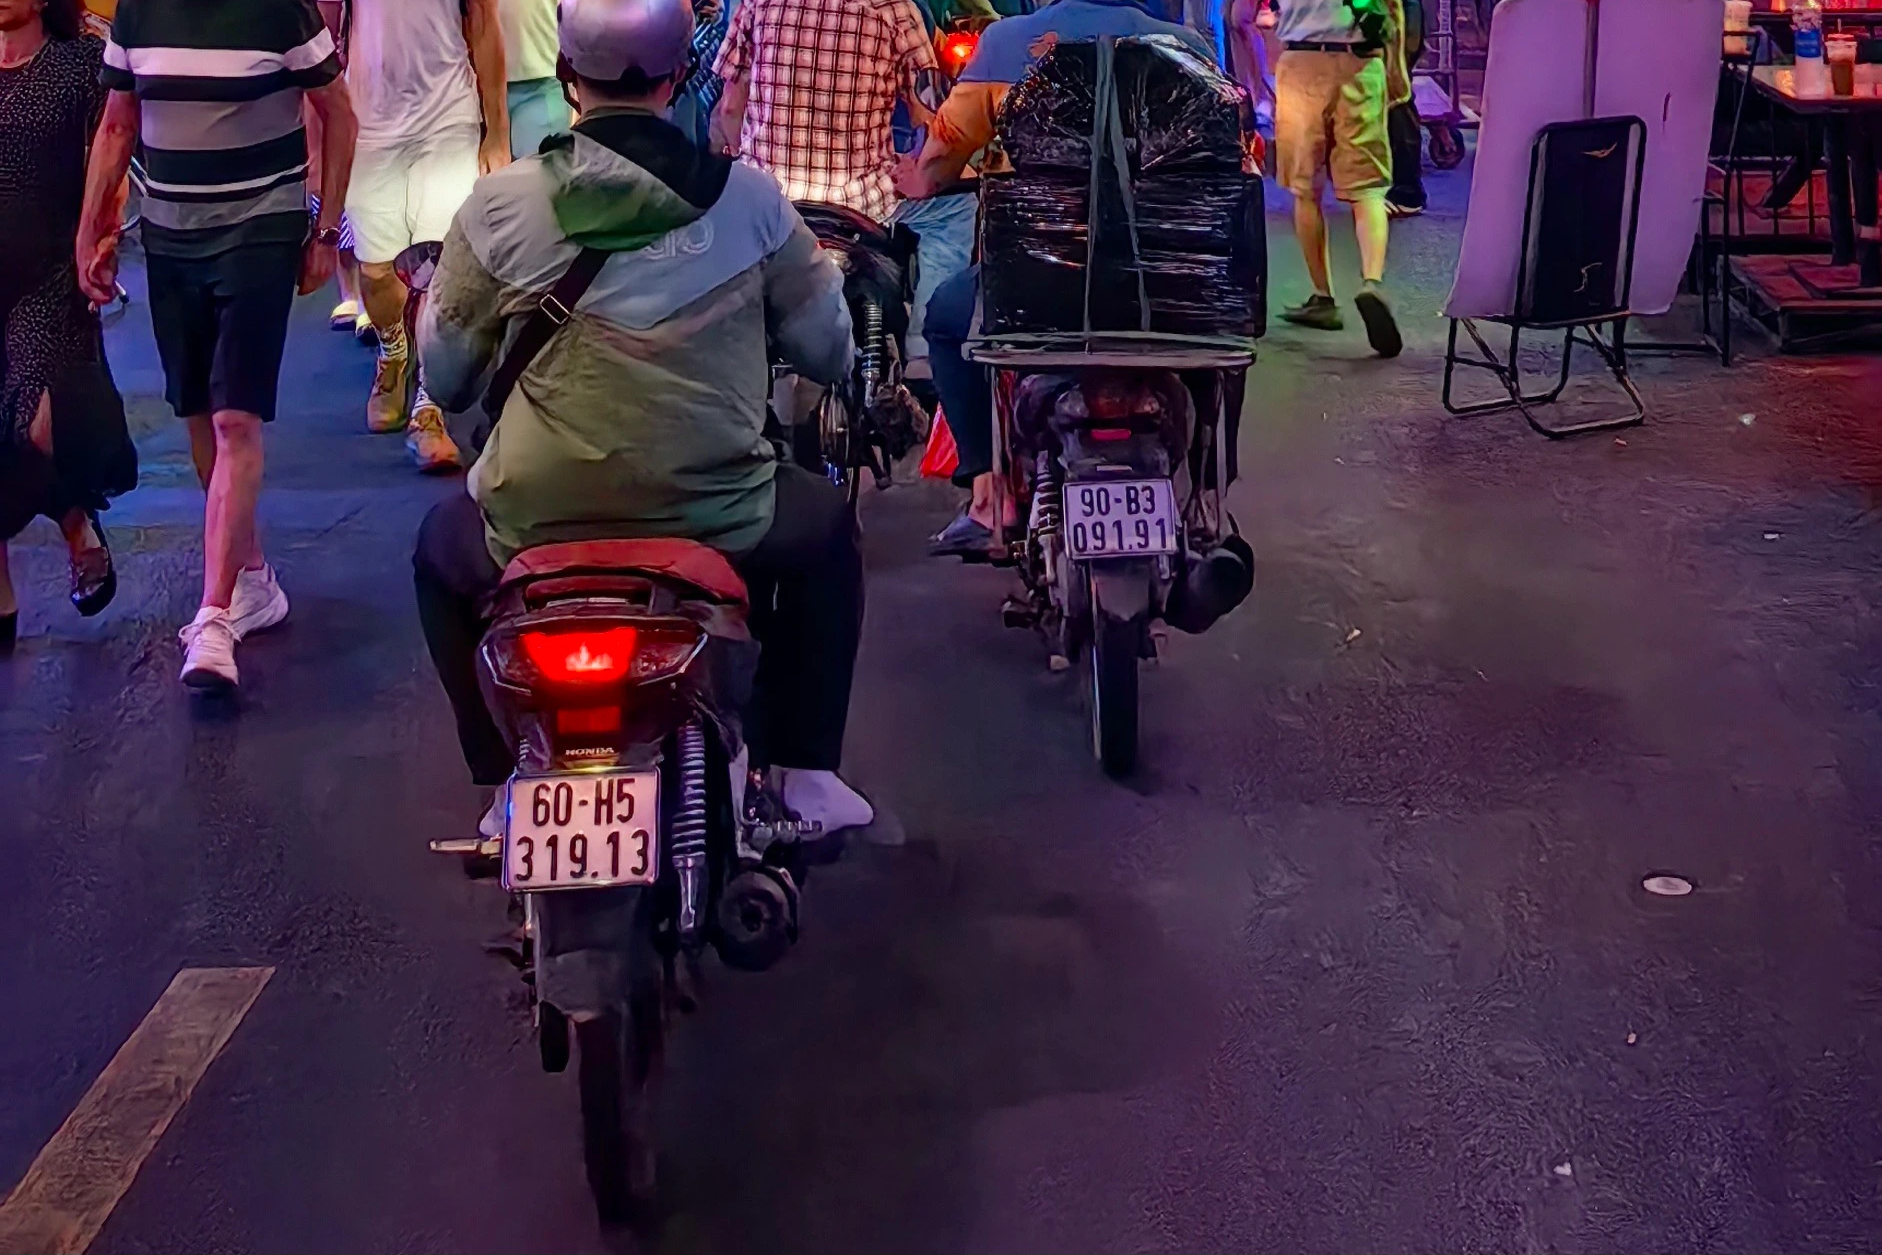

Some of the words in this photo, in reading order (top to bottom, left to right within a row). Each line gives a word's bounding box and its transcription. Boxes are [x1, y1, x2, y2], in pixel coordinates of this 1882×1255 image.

[1081, 485, 1155, 517] 90-B3
[1073, 518, 1166, 553] 091.91
[565, 747, 615, 756] HONDA
[533, 778, 635, 827] 60-H5
[516, 829, 650, 881] 319.13
